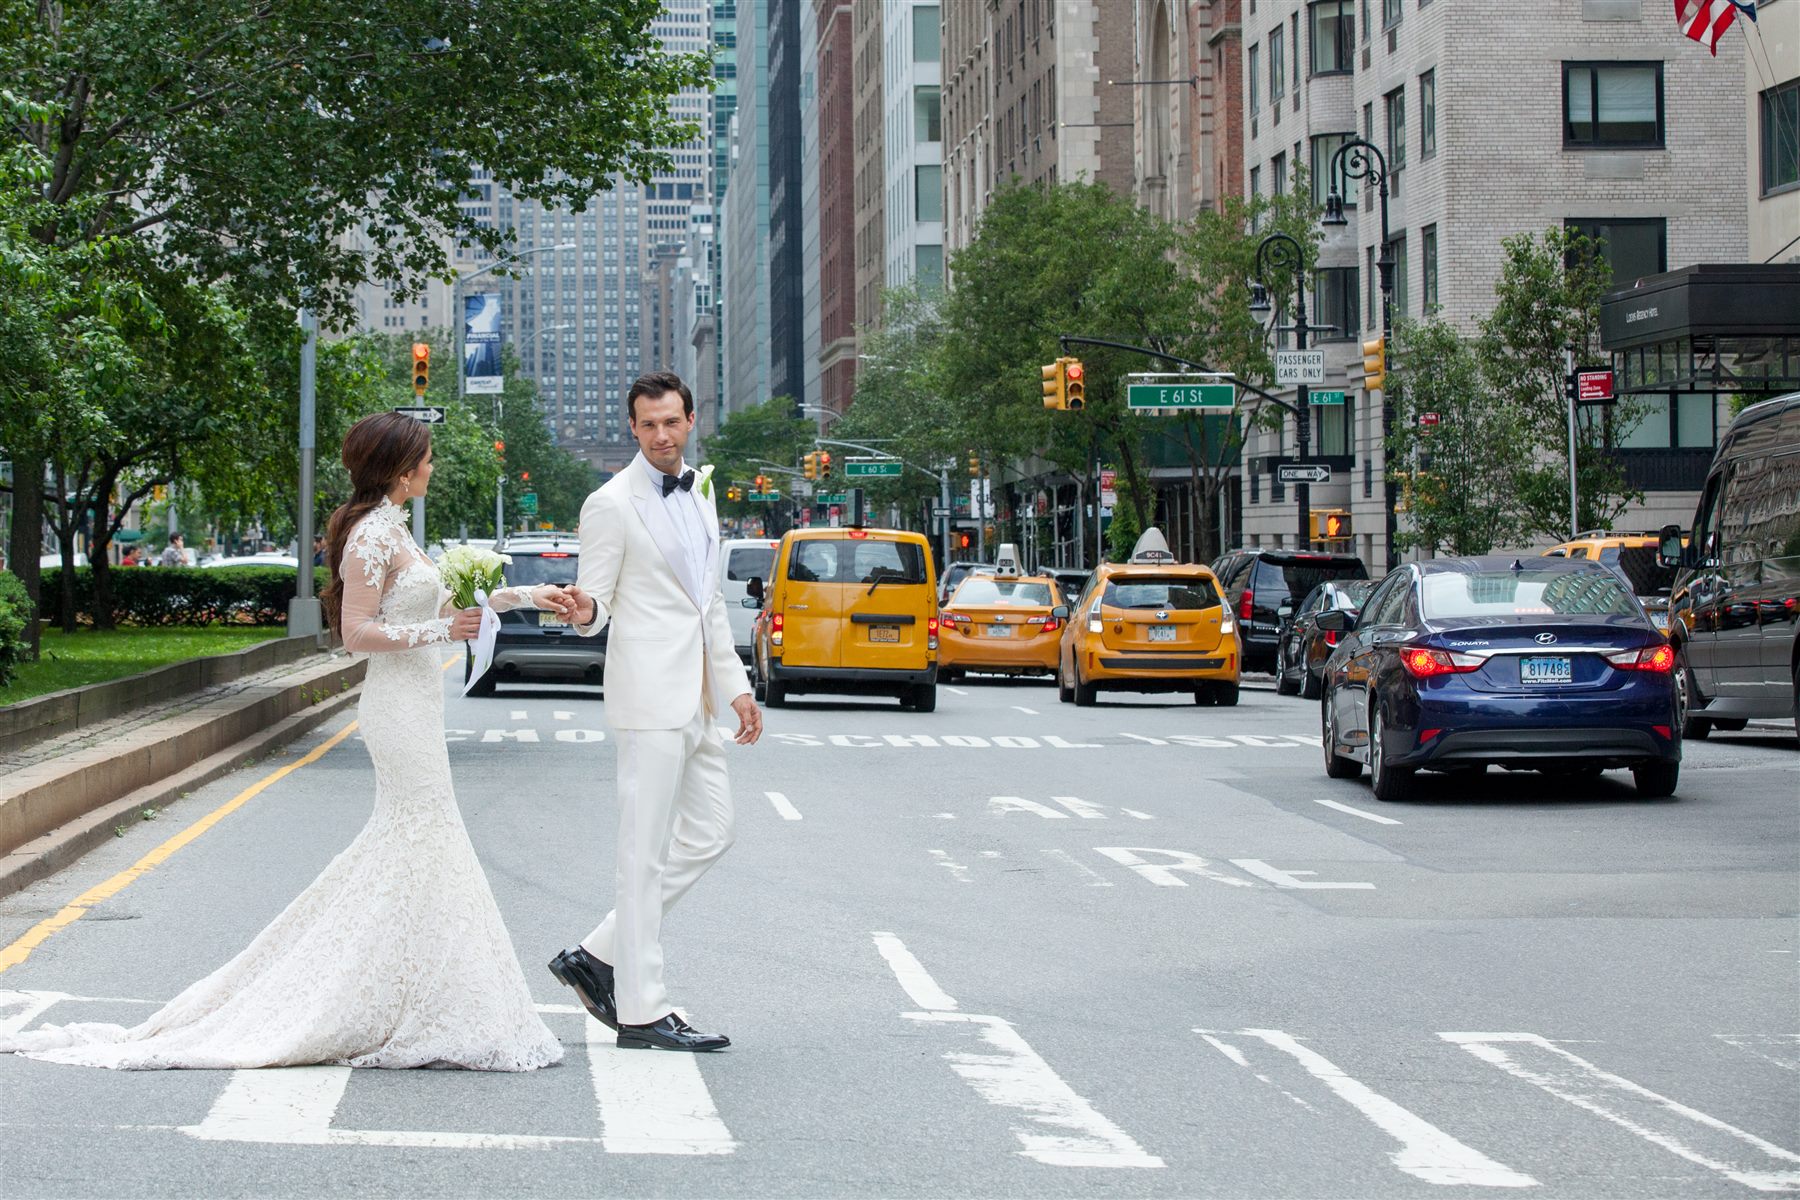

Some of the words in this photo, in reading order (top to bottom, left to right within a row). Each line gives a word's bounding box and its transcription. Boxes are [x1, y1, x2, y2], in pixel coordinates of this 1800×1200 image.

[1278, 355, 1321, 365] PASSENGER
[1278, 368, 1298, 378] CARS
[1302, 368, 1321, 378] ONLY
[1160, 389, 1167, 403] E
[1173, 389, 1184, 403] 61
[1189, 389, 1203, 403] St
[1313, 393, 1319, 403] E
[1322, 393, 1331, 403] 61
[861, 465, 866, 474] E
[868, 465, 877, 474] 60
[1283, 470, 1298, 478] ONE
[1307, 470, 1323, 478] WAY
[770, 734, 1104, 748] SCHOOL
